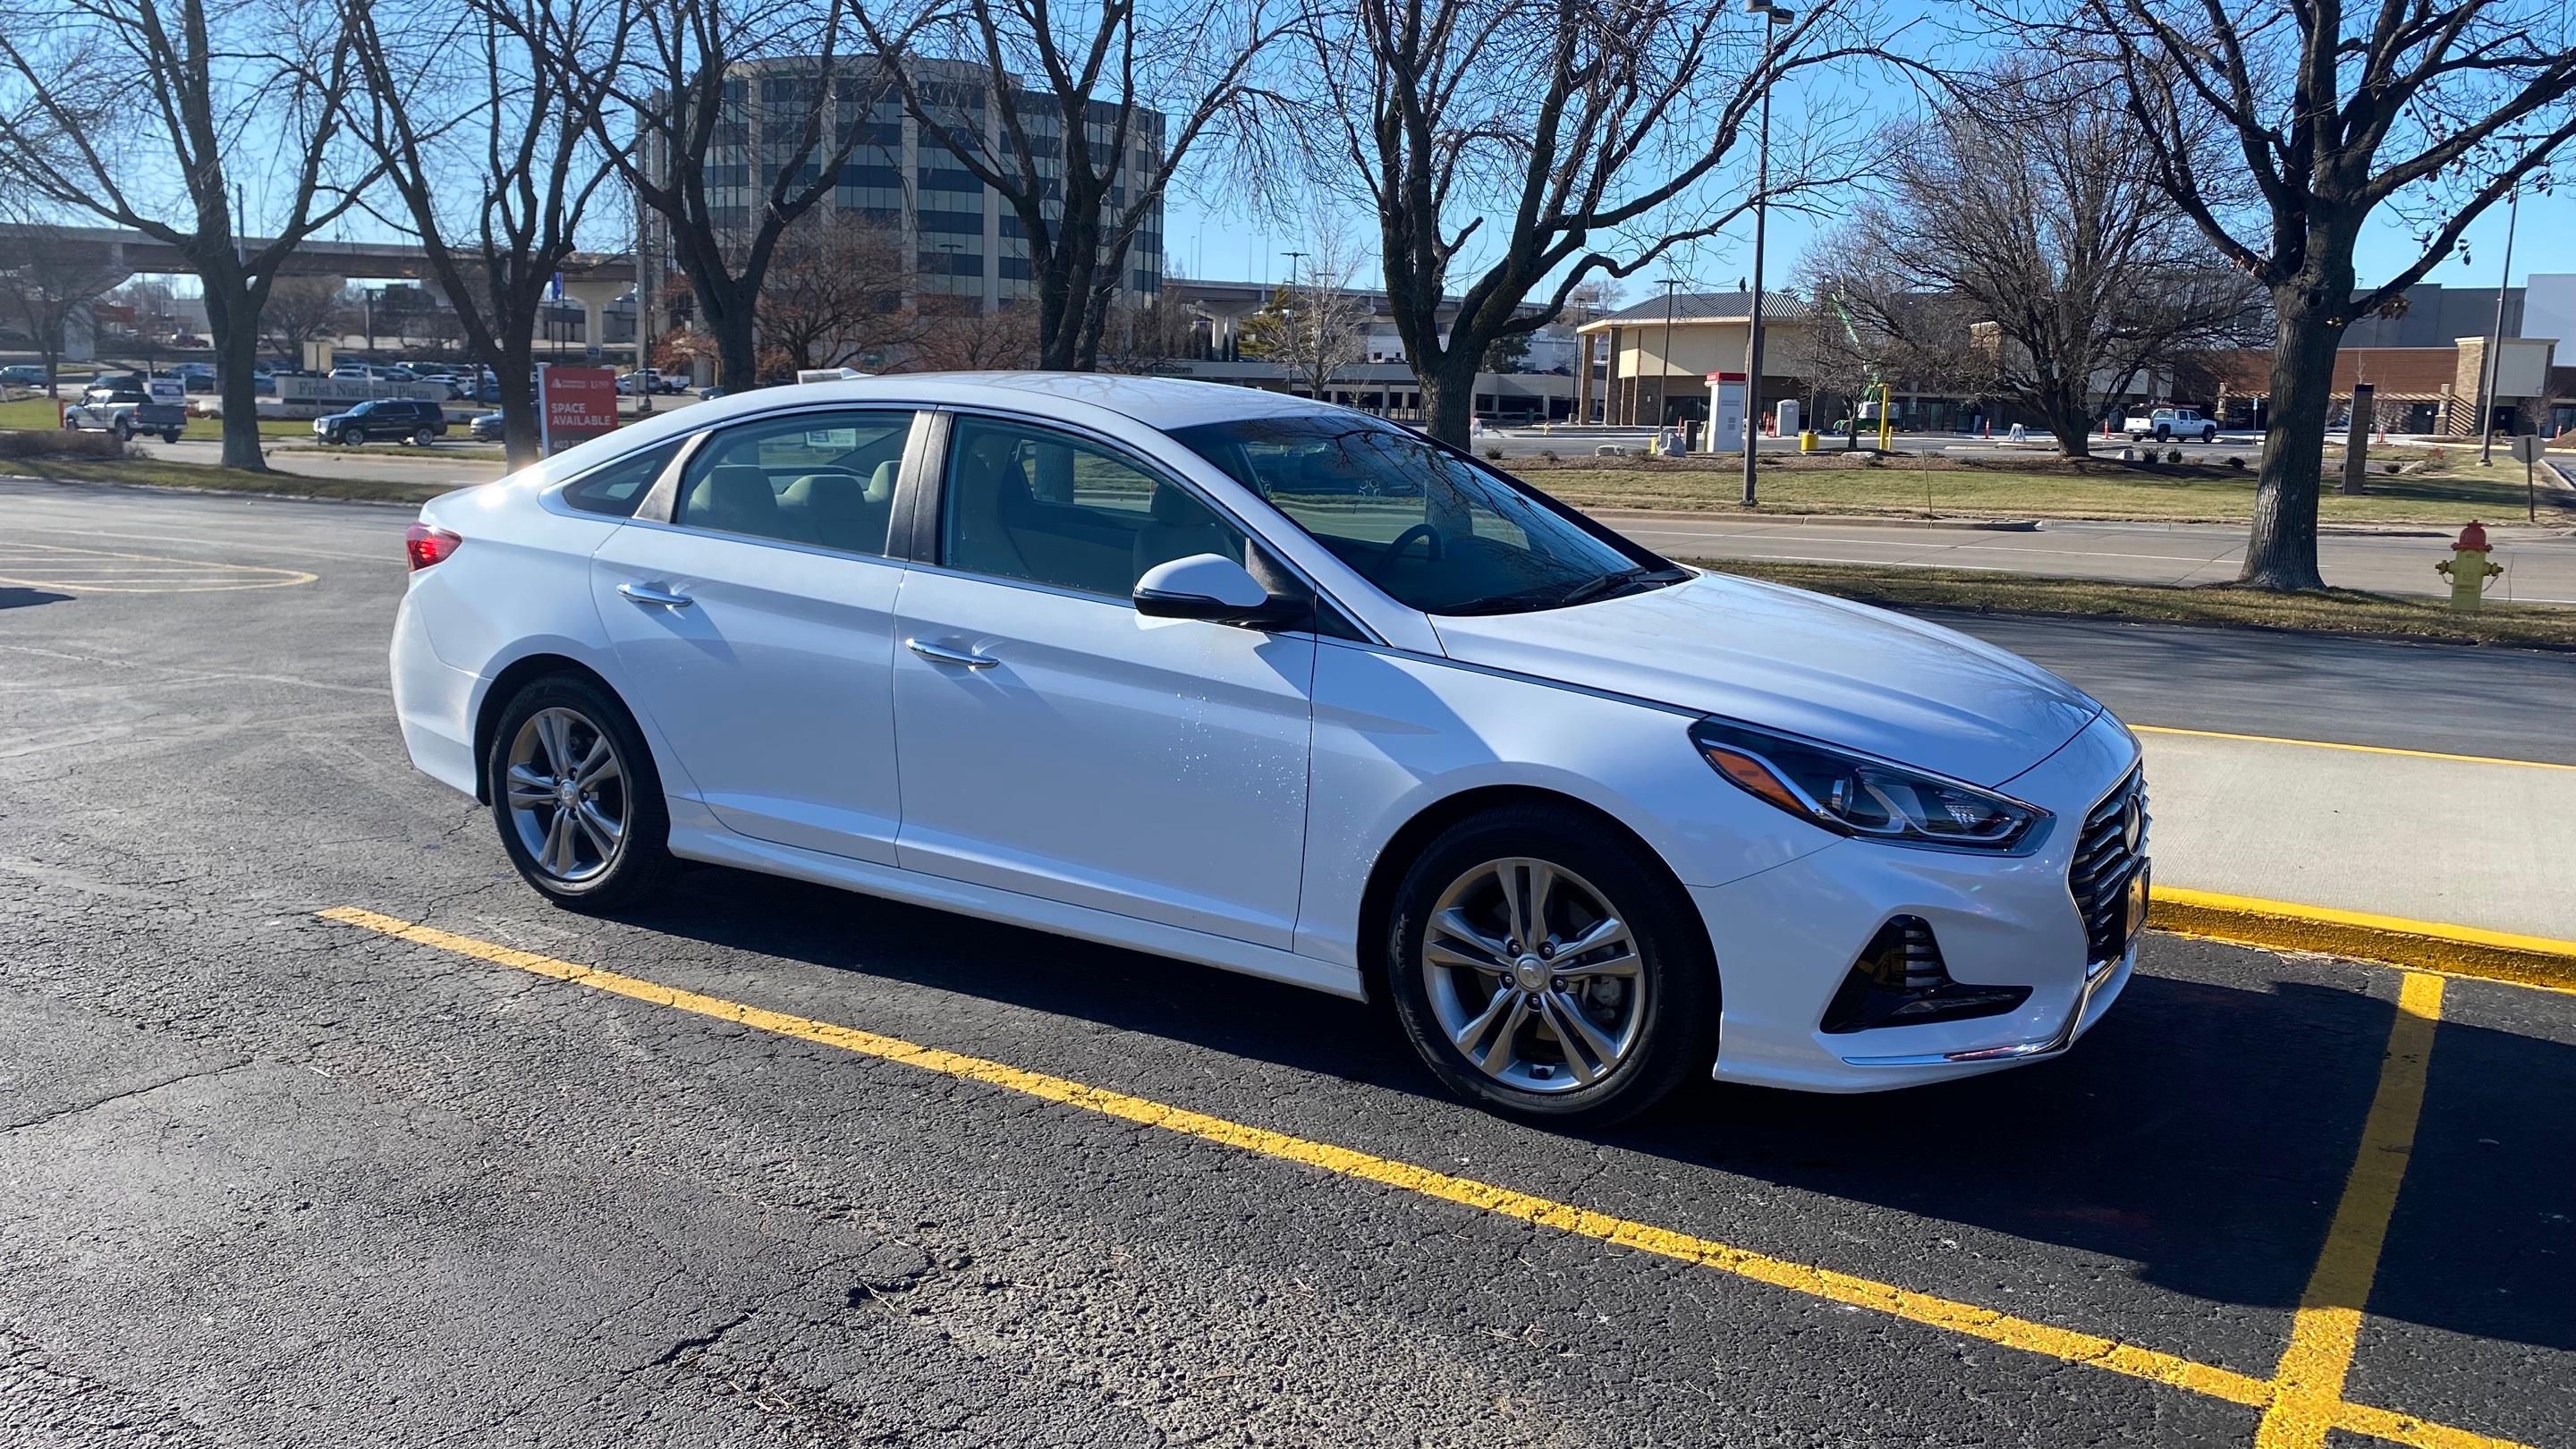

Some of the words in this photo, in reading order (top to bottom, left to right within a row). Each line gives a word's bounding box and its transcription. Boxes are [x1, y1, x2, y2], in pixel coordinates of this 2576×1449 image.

[298, 382, 330, 394] First
[336, 382, 393, 397] National
[396, 386, 430, 397] Plaza
[551, 403, 586, 413] SPACE
[553, 416, 611, 425] AVAILABLE
[554, 440, 569, 449] 402
